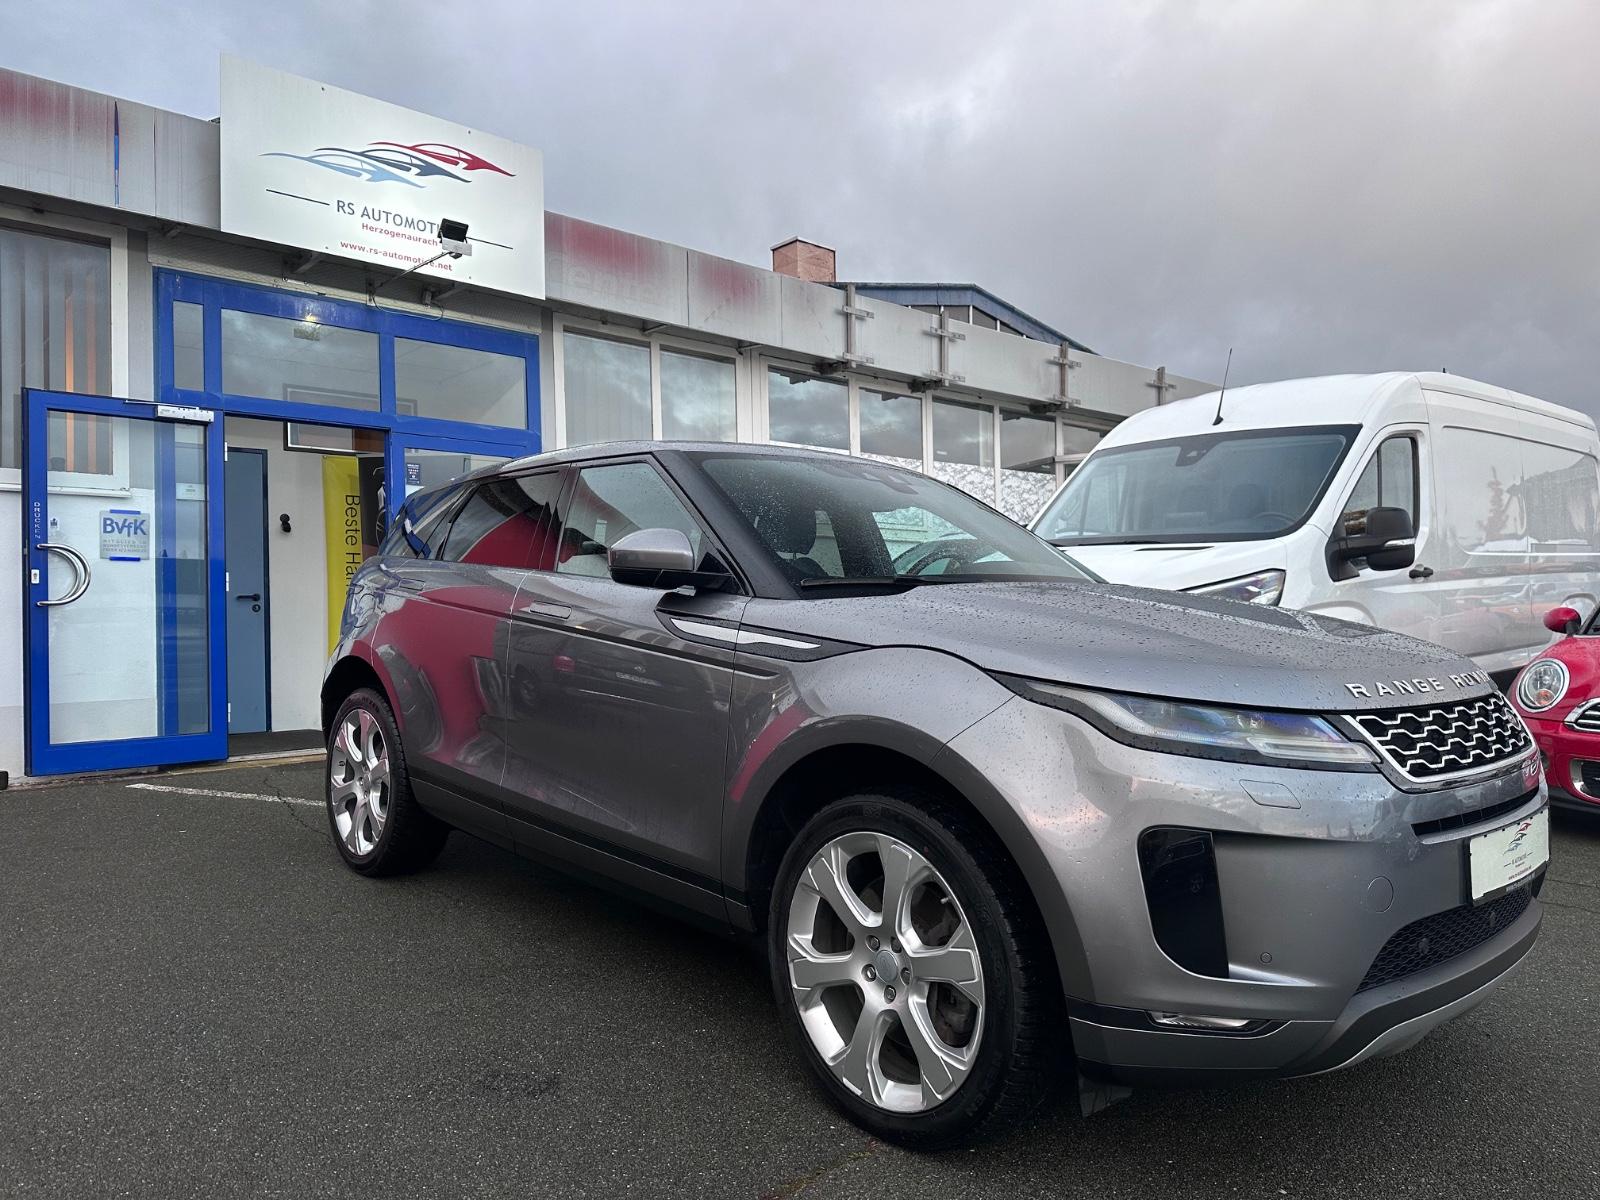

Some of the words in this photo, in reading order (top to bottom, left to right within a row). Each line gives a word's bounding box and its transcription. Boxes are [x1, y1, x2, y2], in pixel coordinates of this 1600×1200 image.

[336, 199, 355, 215] RS
[360, 206, 440, 235] AUTOMOTI
[361, 222, 438, 247] Herzogenaurach
[340, 241, 453, 272] www.rs-automotie.net
[344, 494, 361, 546] Beste
[1344, 677, 1445, 699] RANGE
